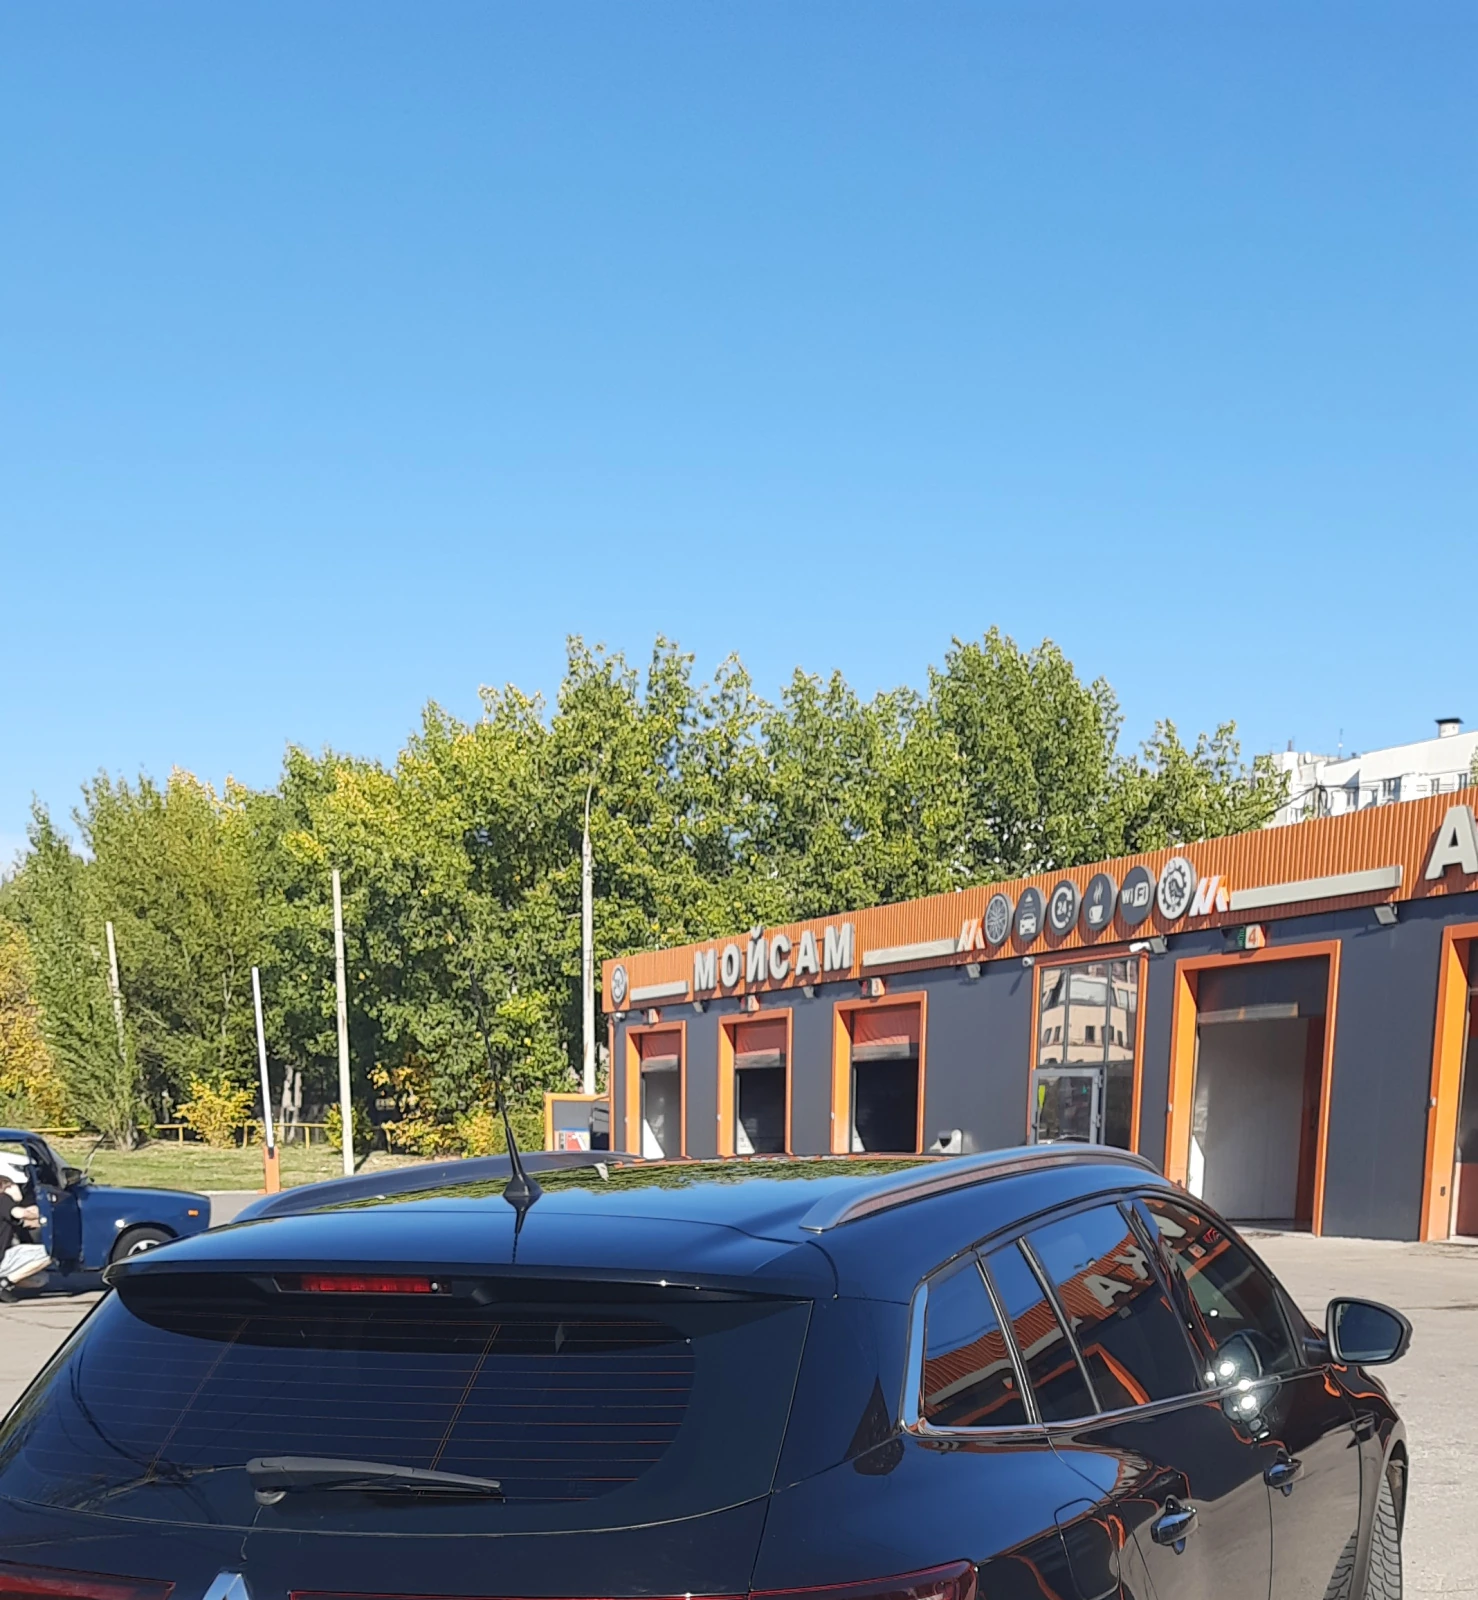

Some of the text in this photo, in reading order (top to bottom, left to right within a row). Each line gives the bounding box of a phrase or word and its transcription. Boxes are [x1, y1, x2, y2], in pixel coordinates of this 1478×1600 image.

[1057, 901, 1067, 915] 24
[1247, 927, 1258, 945] 4
[694, 923, 855, 992] МОЙСАМ
